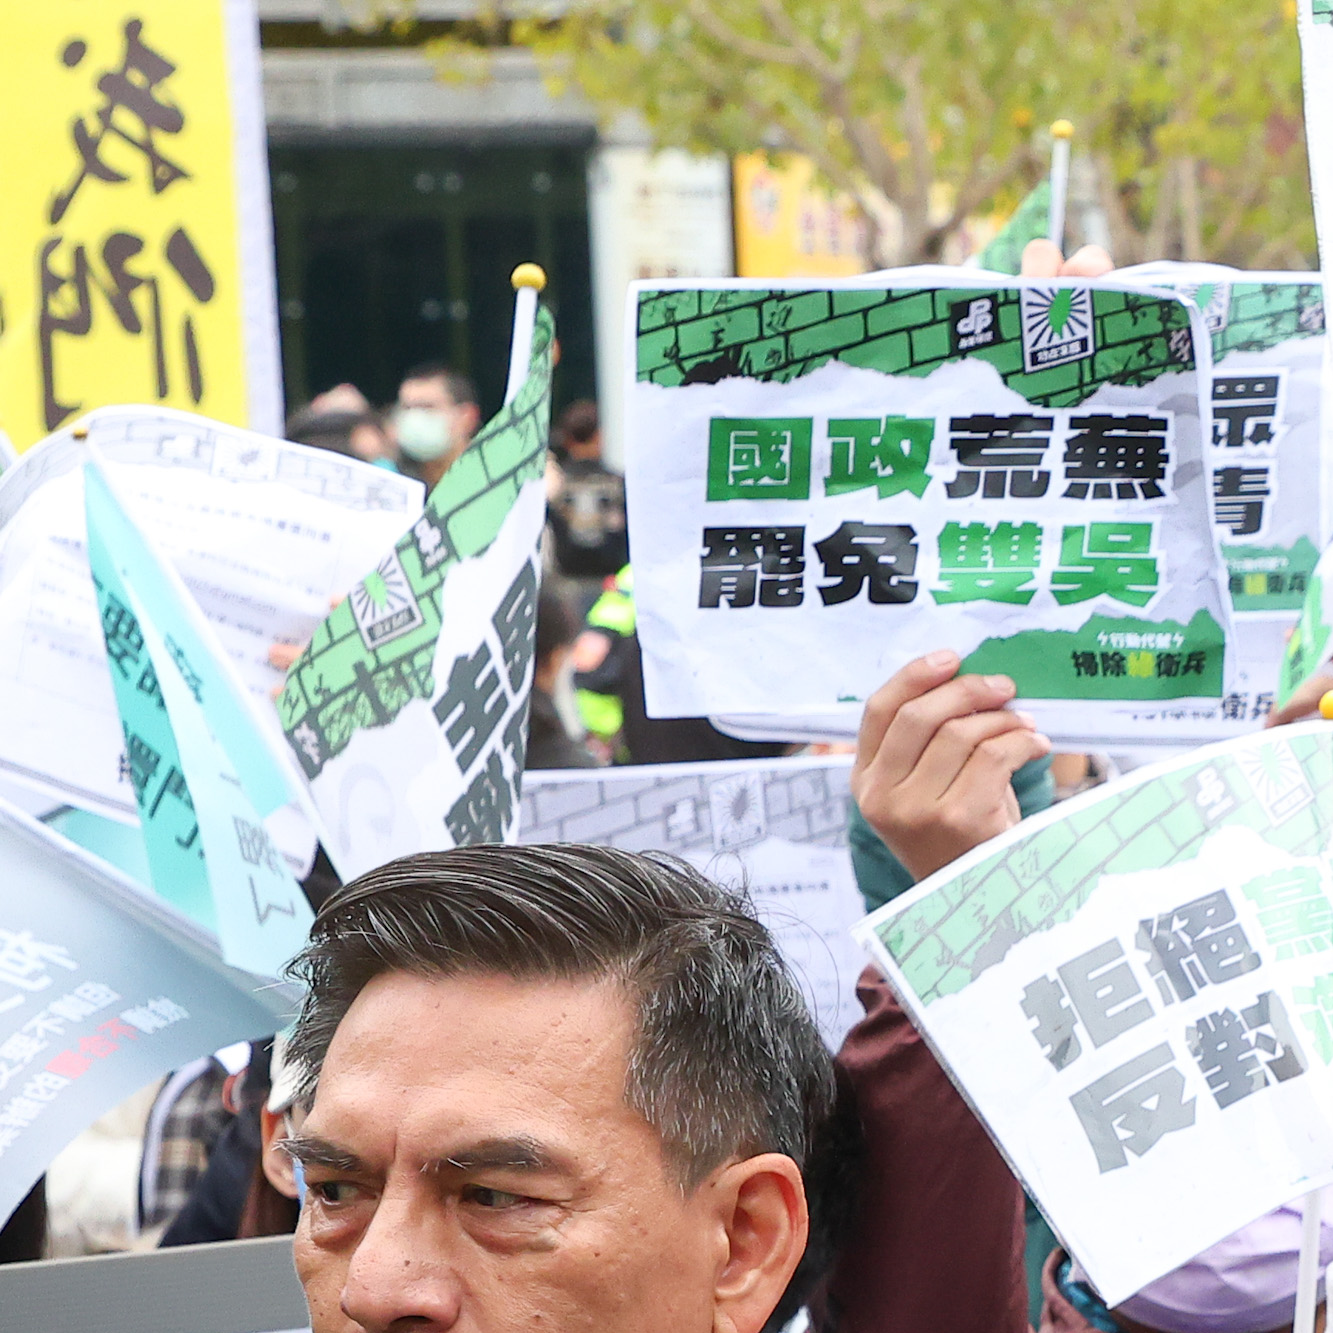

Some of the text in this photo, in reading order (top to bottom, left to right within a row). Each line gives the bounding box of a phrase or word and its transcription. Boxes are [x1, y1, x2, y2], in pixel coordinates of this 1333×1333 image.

[705, 413, 1171, 502] 國政荒蕪
[698, 520, 1160, 608] 罷免雙吳
